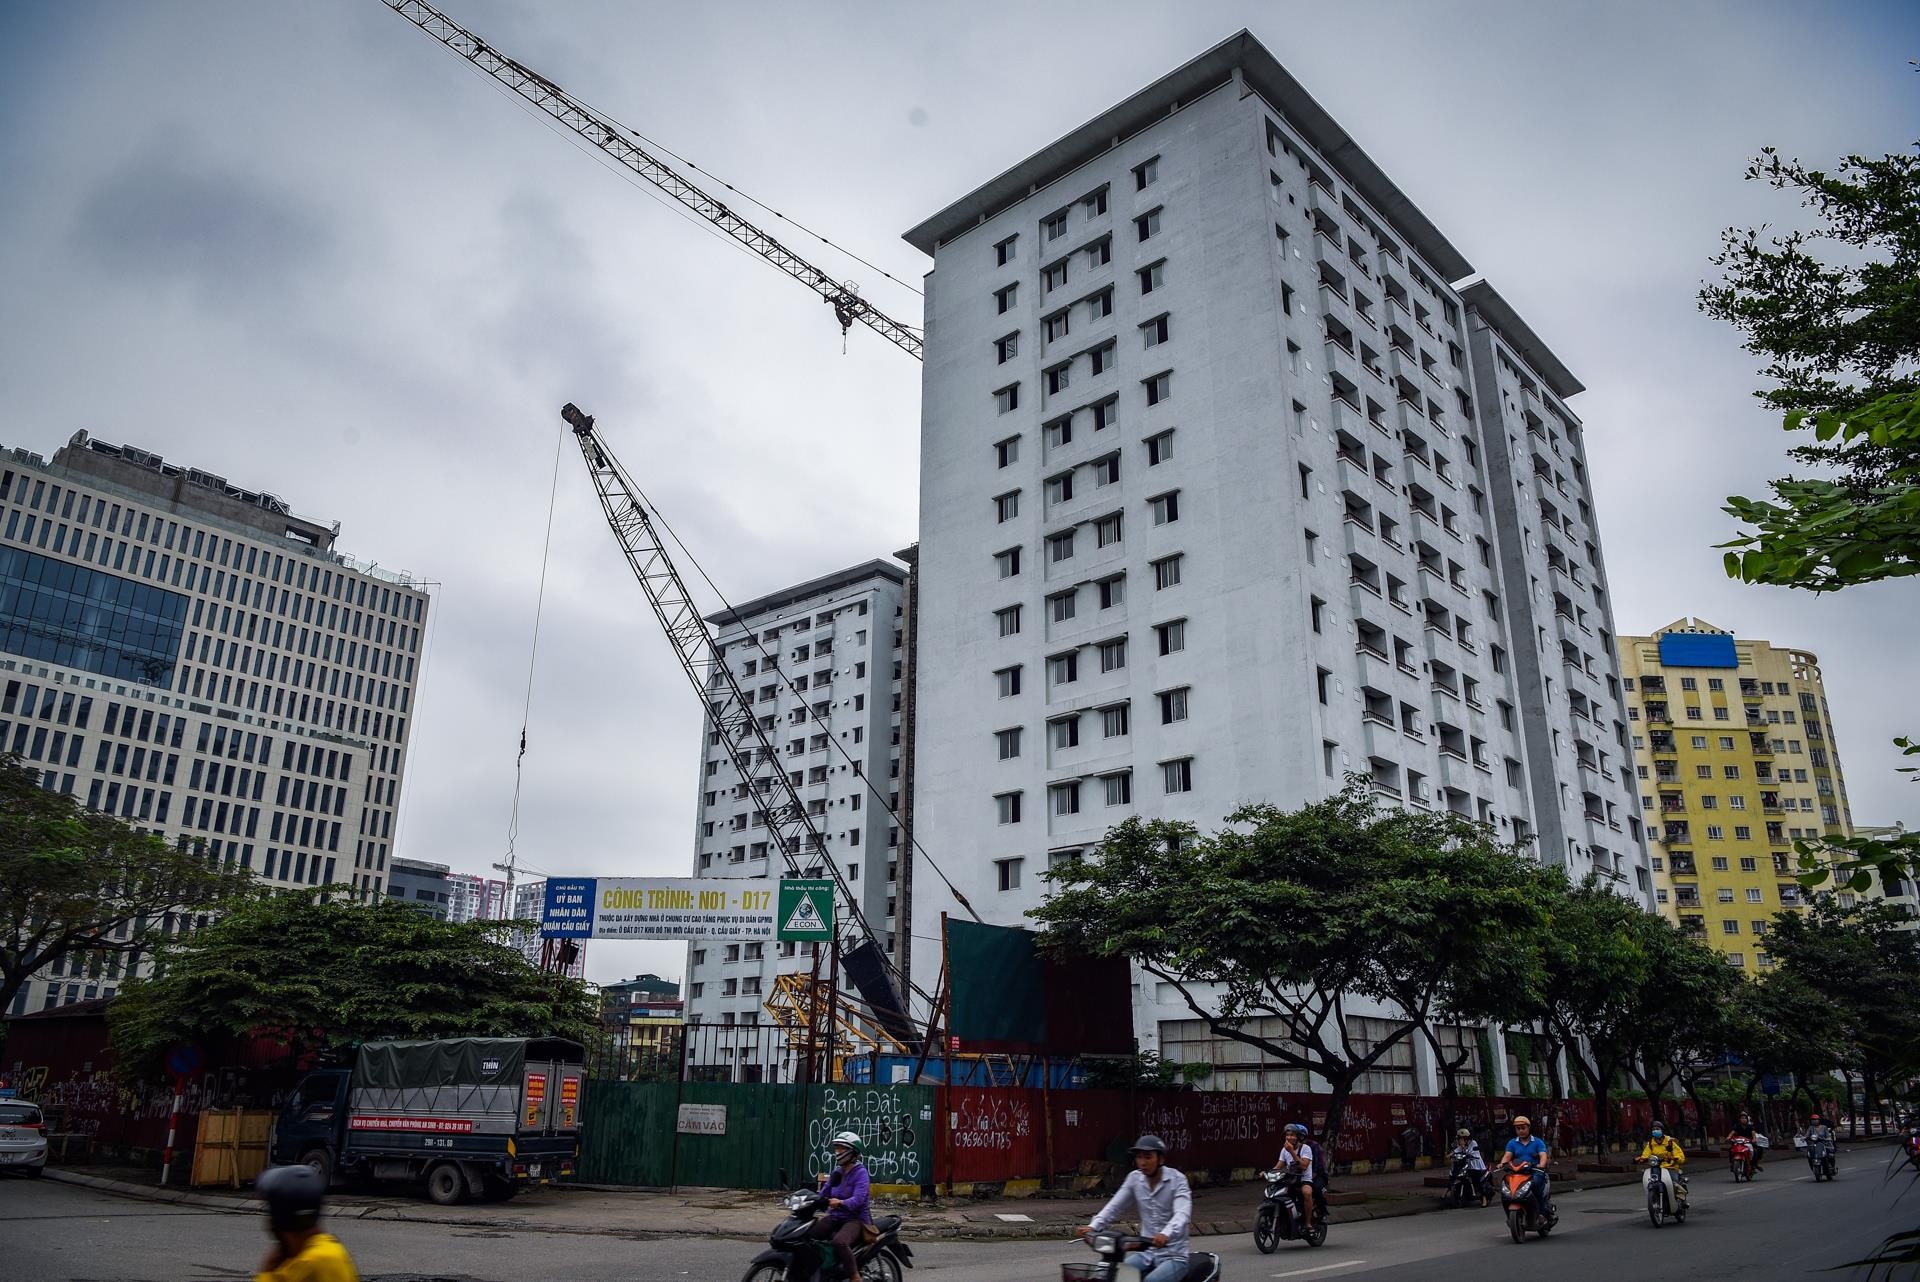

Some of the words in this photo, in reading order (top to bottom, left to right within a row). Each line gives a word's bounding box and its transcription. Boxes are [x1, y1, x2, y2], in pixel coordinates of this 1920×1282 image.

[567, 895, 583, 904] BAN
[603, 886, 644, 910] CÔNG
[647, 886, 694, 910] TRÌNH:
[742, 891, 771, 911] D17
[549, 907, 570, 917] NHÂN
[571, 907, 587, 917] DÂN
[599, 914, 615, 924] THUỘC
[623, 914, 633, 922] XÂY
[634, 914, 648, 924] DỰNG
[649, 914, 660, 922] NHÀ
[665, 915, 683, 923] CHUNG
[691, 915, 702, 923] CAO
[702, 914, 716, 923] TẦNG
[717, 915, 731, 924] PHỤC
[745, 915, 757, 923] DÂN
[543, 920, 561, 933] QUẬN
[561, 919, 575, 931] CẦU
[575, 919, 591, 932] GIẤY
[644, 926, 655, 934] KHU
[695, 925, 707, 934] GIẤY
[729, 925, 741, 935] GIẤY
[745, 927, 753, 935] TP.
[753, 926, 761, 935] HÀ
[761, 926, 771, 936] NỘI
[808, 1150, 920, 1178] 0901313
